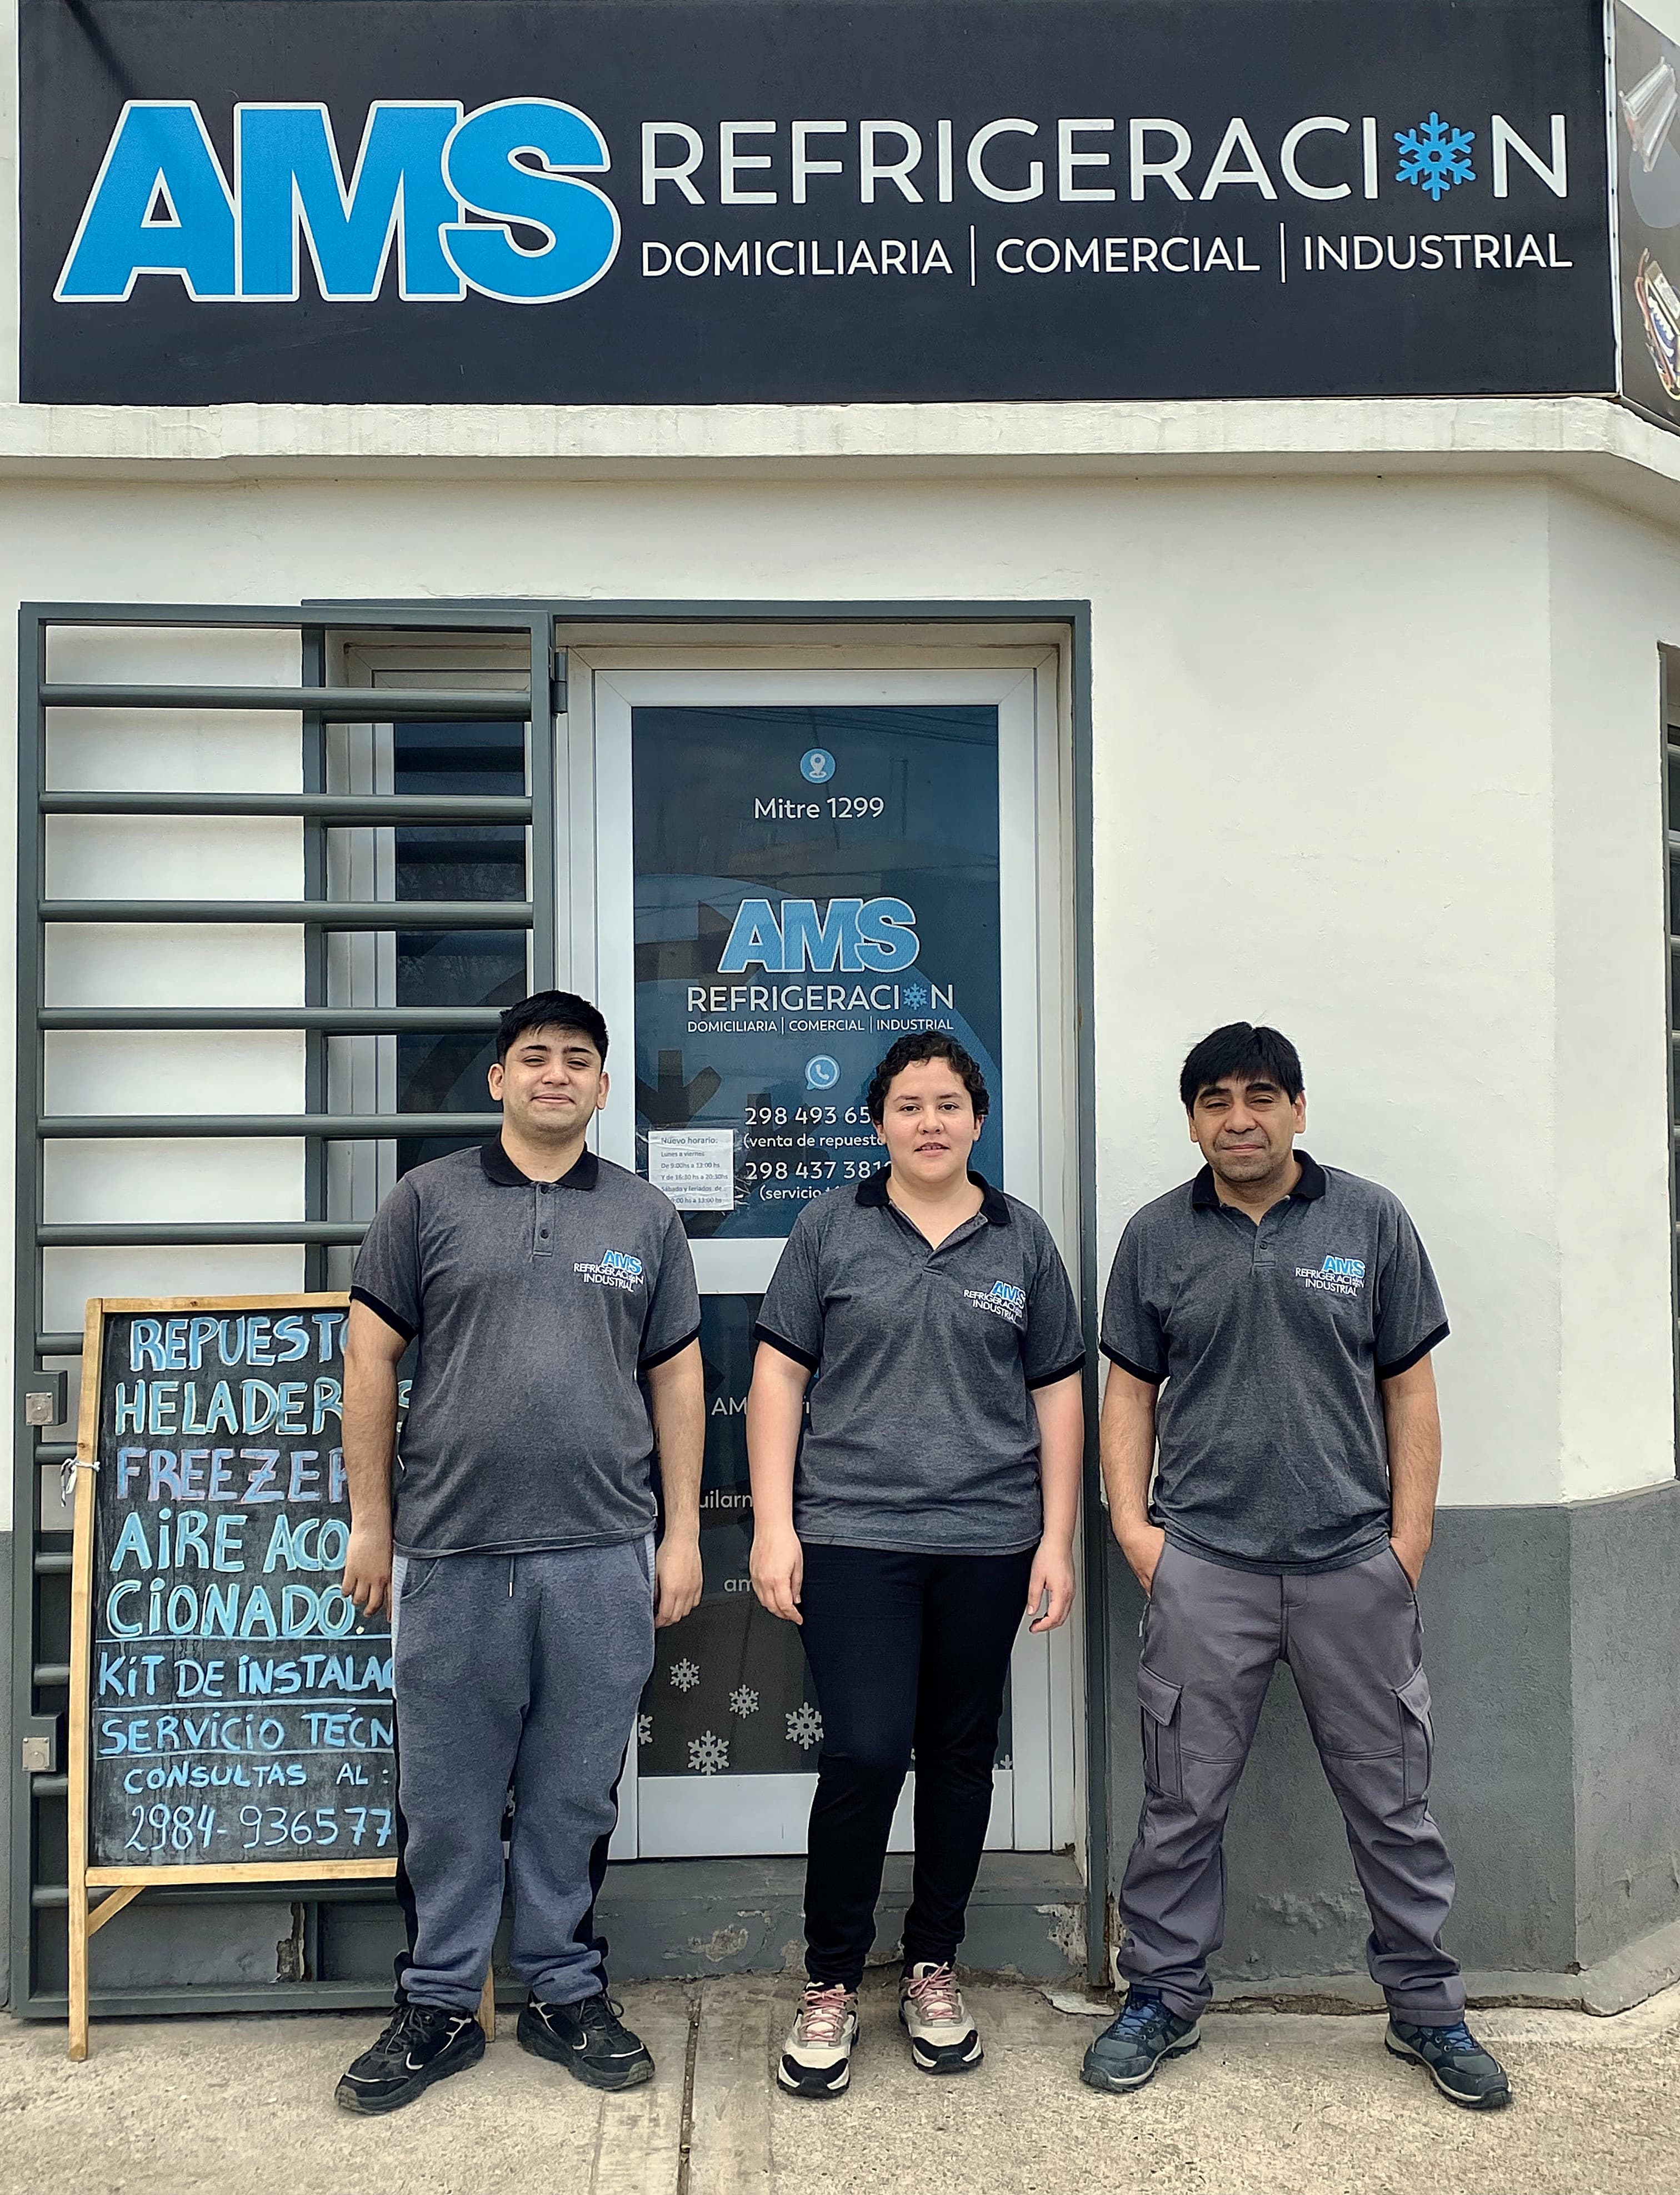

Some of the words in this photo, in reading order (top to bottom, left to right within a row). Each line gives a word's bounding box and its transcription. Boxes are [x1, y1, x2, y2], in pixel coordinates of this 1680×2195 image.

[641, 111, 1568, 204] REFRIGERACIN
[53, 97, 622, 304] AMS
[641, 239, 953, 277] DOMICILIARIA
[996, 237, 1261, 274] COMERCIAL
[1304, 233, 1573, 271] INDUSTRIAL
[754, 797, 820, 819] Mitre
[827, 797, 884, 818] 1299
[717, 897, 920, 973] AMS
[687, 982, 954, 1012] REFRIGERACIN
[687, 1019, 778, 1033] DOMICILIARIA
[789, 1018, 865, 1032] COMERCIAL
[876, 1018, 954, 1031] INDUSTRIAL
[744, 1107, 787, 1125] 298
[794, 1106, 837, 1124] 493
[743, 1133, 793, 1149] (venta
[797, 1133, 815, 1147] de
[745, 1162, 788, 1180] 298
[795, 1161, 837, 1179] 437
[601, 1249, 643, 1276] AMS
[1322, 1254, 1366, 1279] AMS
[583, 1273, 634, 1292] INDUSTRIAL
[1306, 1278, 1358, 1297] INDUSTRIAL
[174, 1658, 225, 1698] DE
[123, 1761, 307, 1794] CONSULTAS
